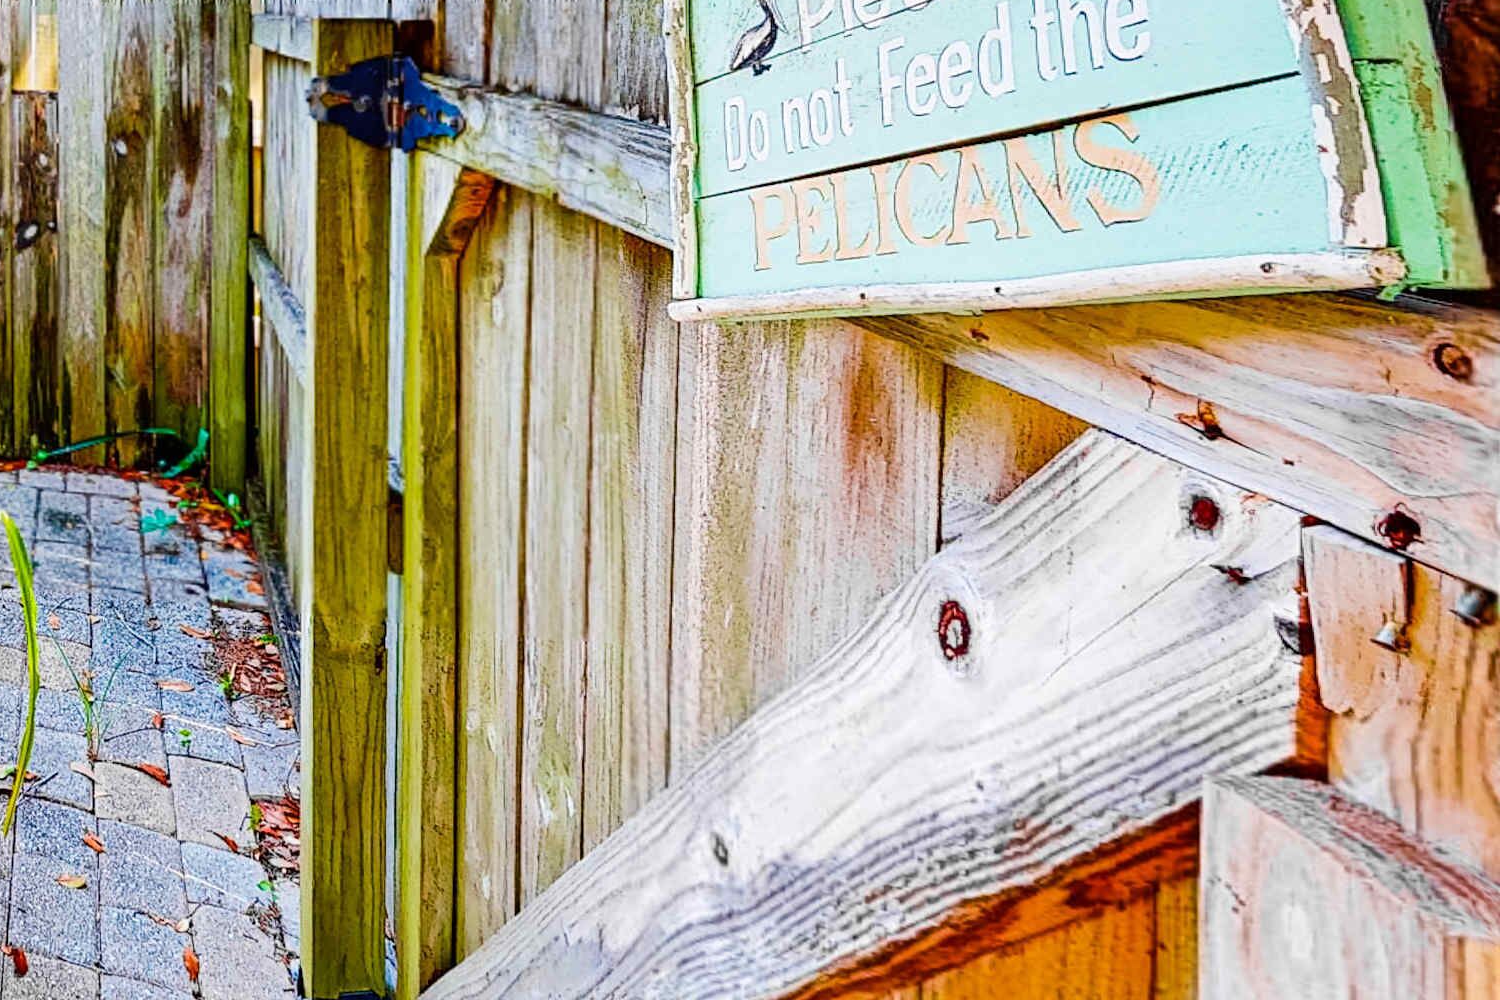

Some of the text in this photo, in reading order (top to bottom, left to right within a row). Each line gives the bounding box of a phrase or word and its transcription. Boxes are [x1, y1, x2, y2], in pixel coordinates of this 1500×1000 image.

[725, 97, 770, 171] Do
[783, 60, 853, 153] not
[879, 3, 1015, 126] Feed
[749, 114, 1161, 271] PELICANS
